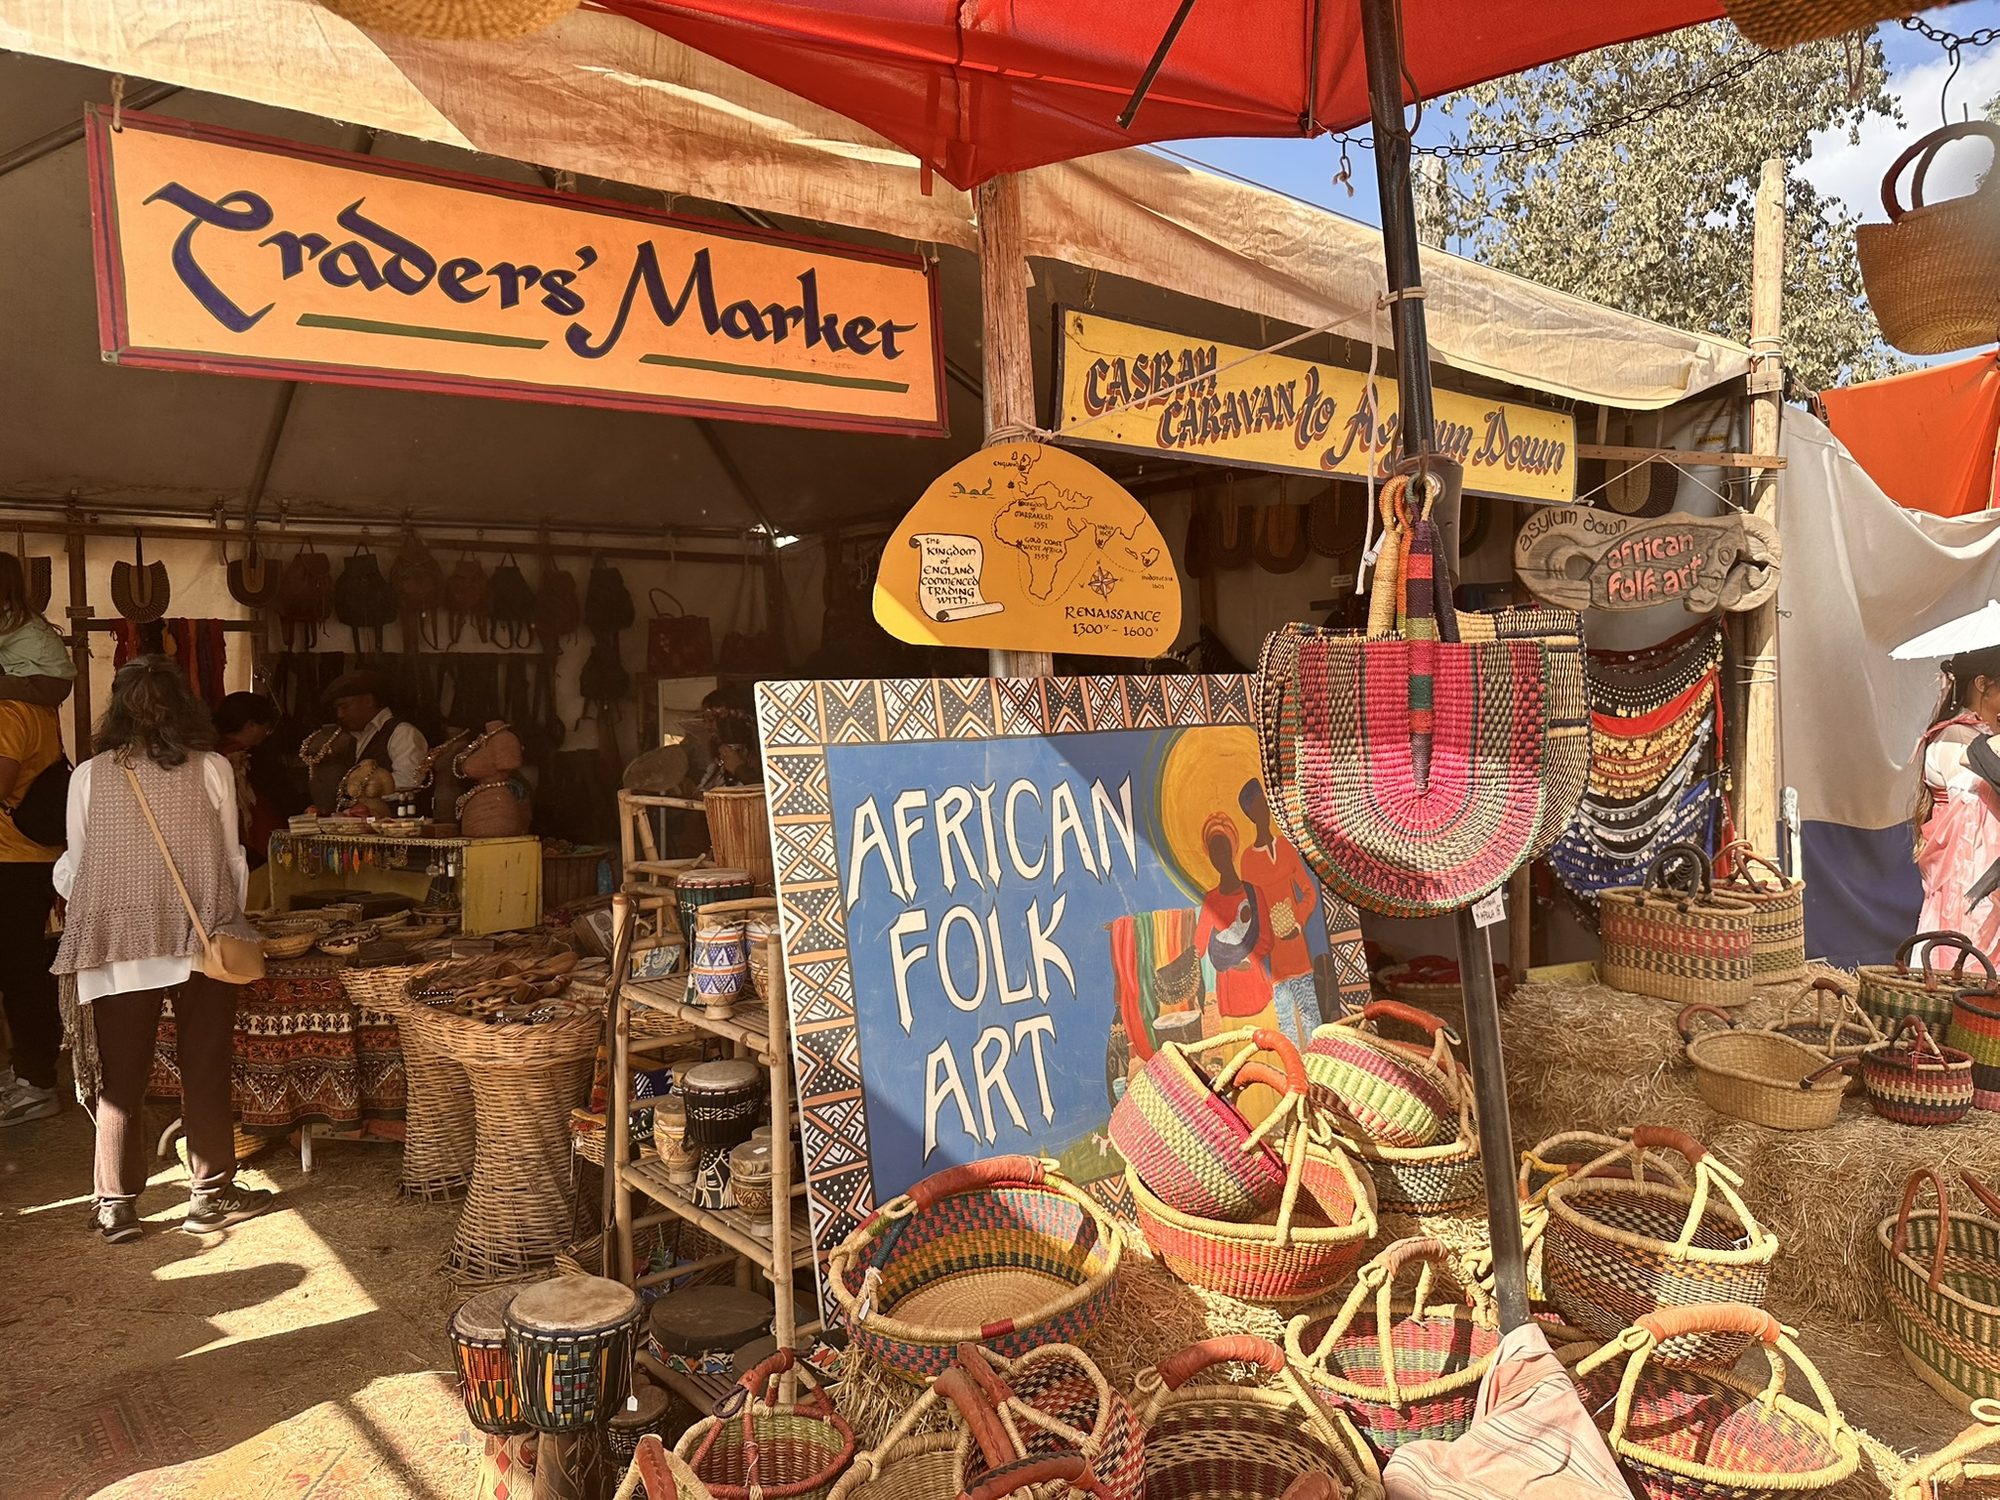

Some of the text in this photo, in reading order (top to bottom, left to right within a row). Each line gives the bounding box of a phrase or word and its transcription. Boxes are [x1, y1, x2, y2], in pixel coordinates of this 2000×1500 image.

[142, 181, 919, 360] Traders' Market
[1084, 345, 1217, 417] CASBAH
[1156, 379, 1296, 448] CARAVAN
[1294, 366, 1337, 450] to
[1472, 406, 1566, 475] Down
[940, 556, 950, 565] of
[1519, 509, 1628, 551] asylum down
[1607, 532, 1694, 569] african
[926, 586, 975, 598] TRADING
[1607, 553, 1702, 603] folk art
[1064, 606, 1161, 623] RENAISSANCE
[846, 770, 1139, 913] AFRICAN
[888, 891, 1077, 1037] FOLK
[922, 1012, 1060, 1169] ART
